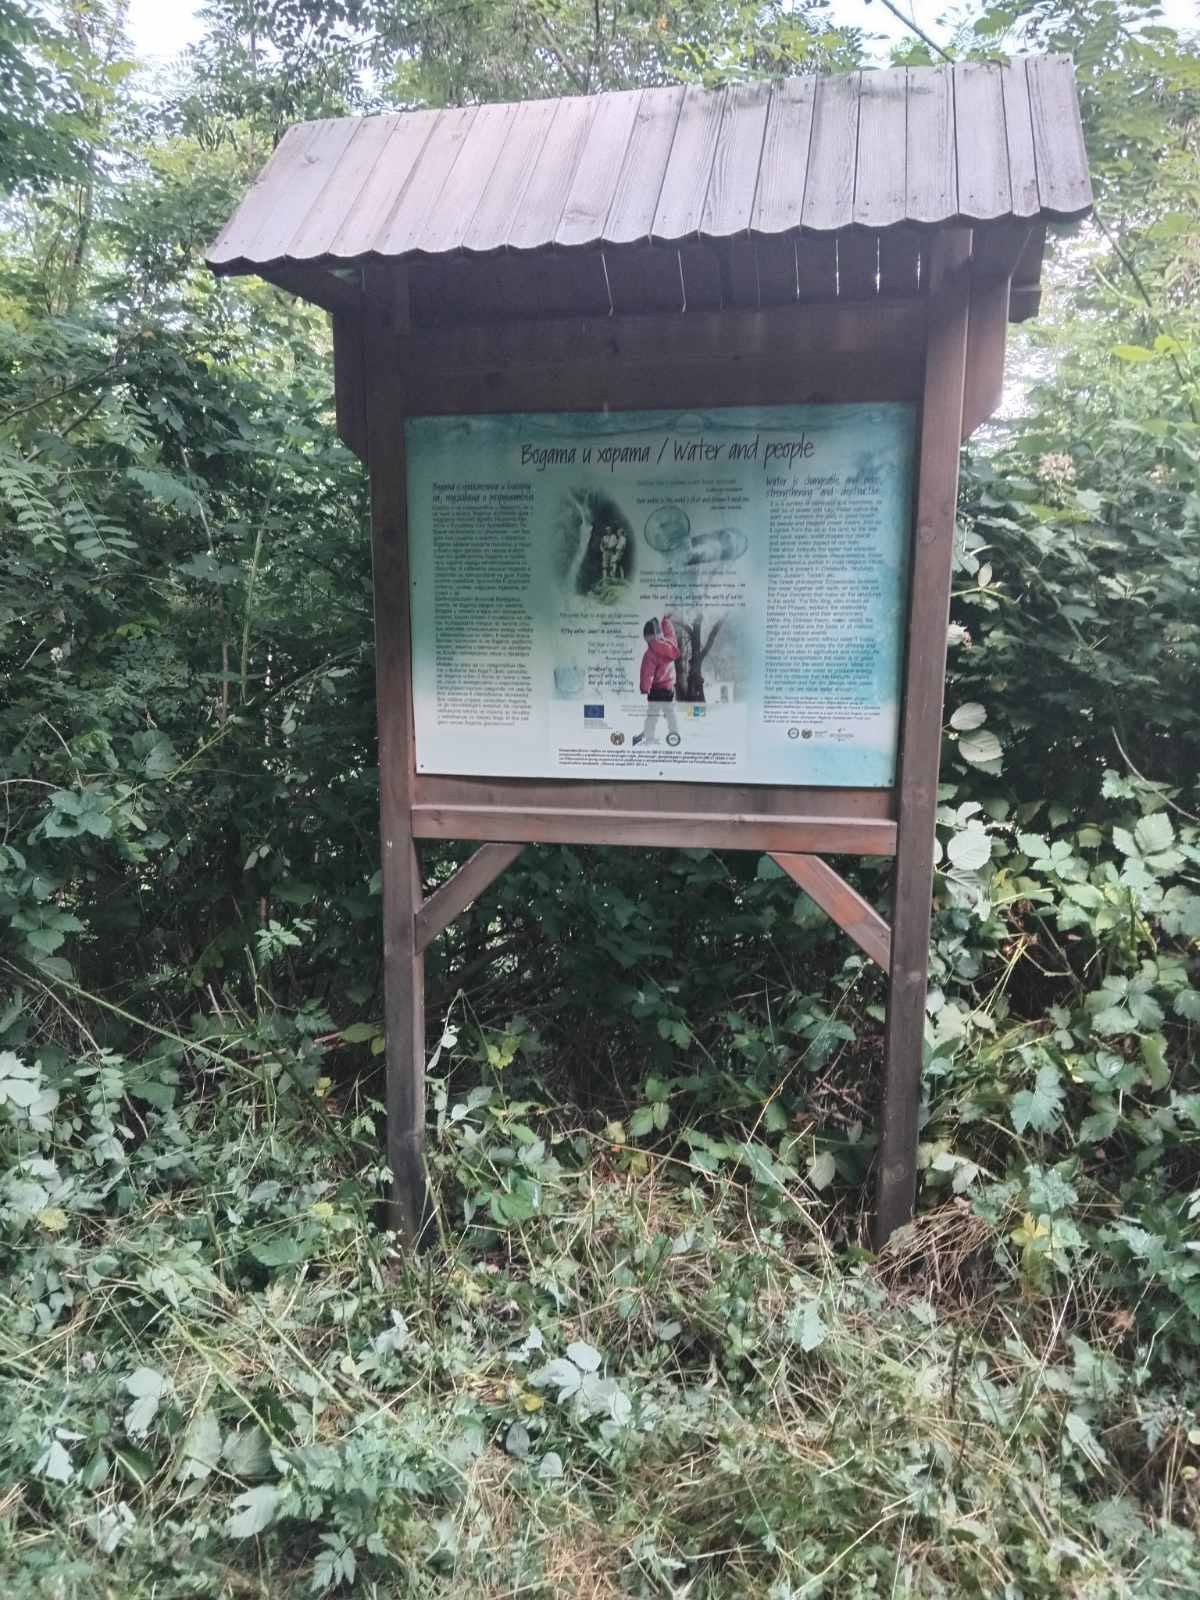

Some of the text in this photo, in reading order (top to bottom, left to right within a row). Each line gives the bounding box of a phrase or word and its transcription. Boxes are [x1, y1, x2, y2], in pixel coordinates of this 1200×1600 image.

[673, 438, 727, 462] Water
[728, 434, 760, 460] and
[763, 432, 815, 471] people
